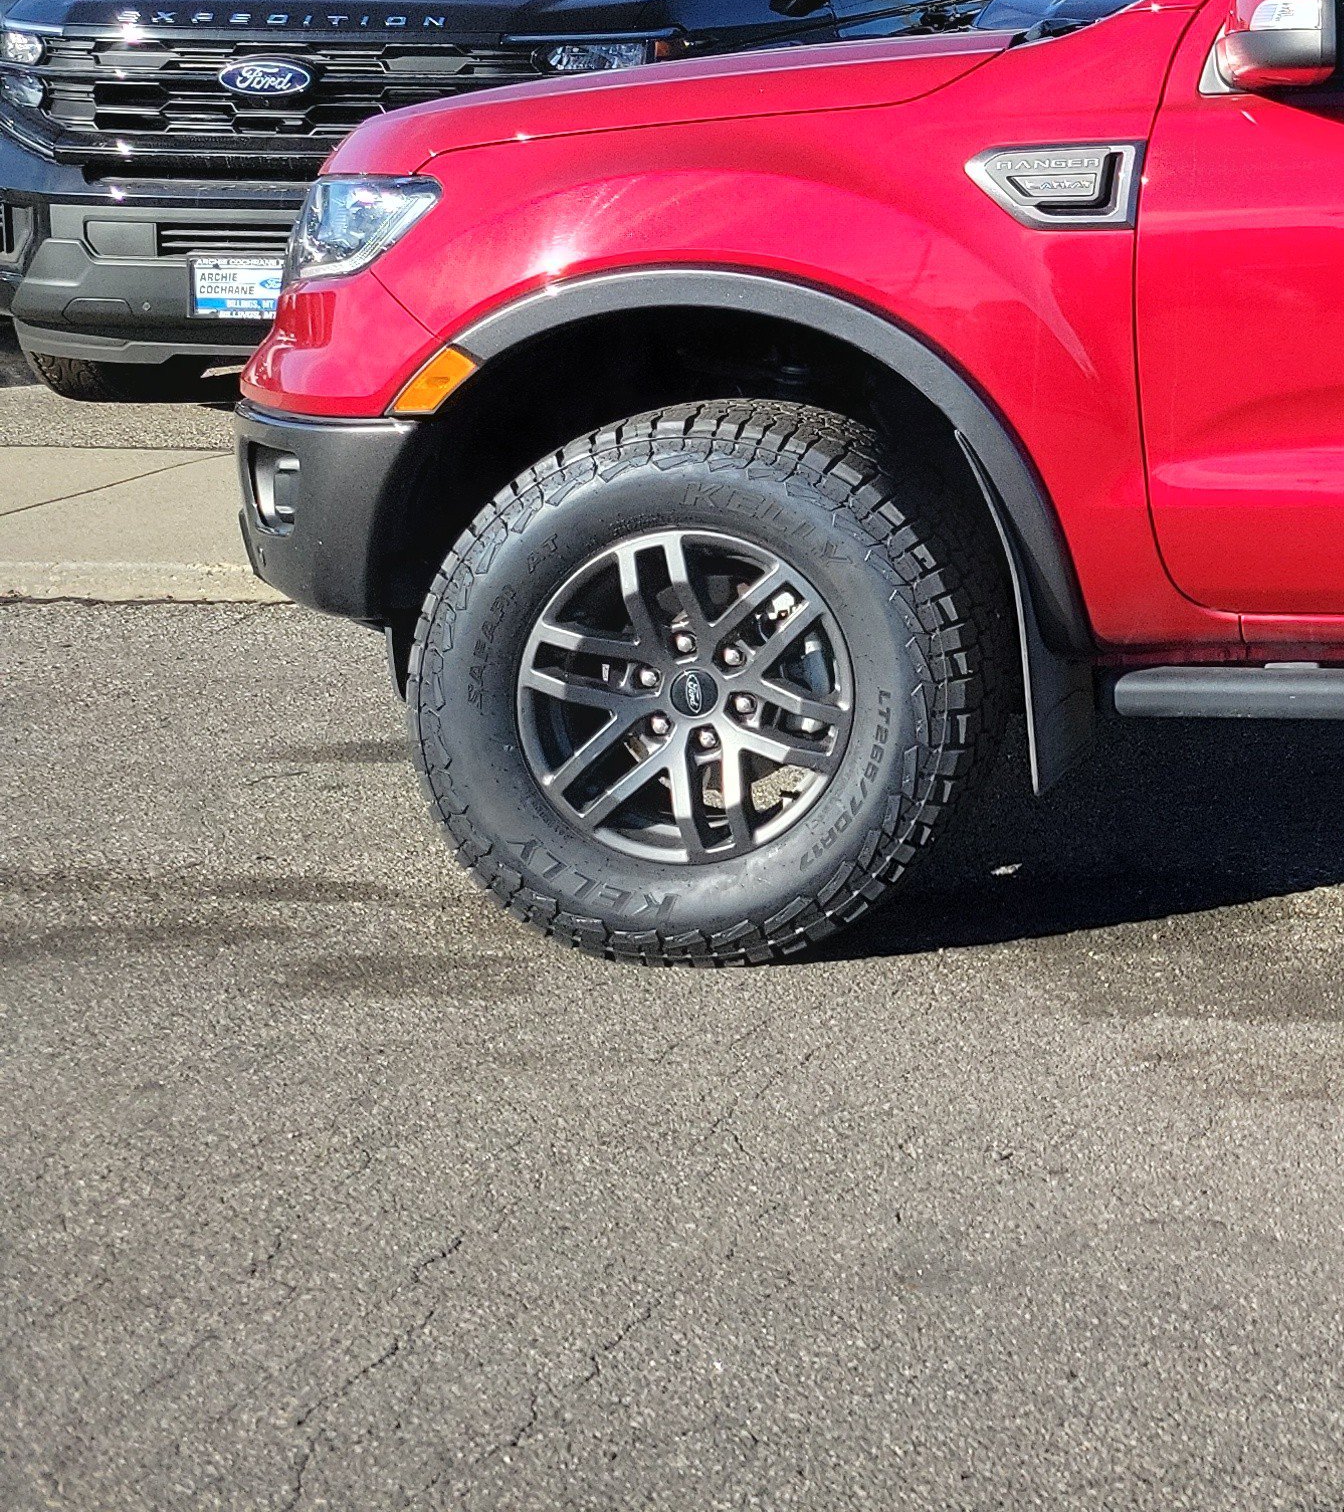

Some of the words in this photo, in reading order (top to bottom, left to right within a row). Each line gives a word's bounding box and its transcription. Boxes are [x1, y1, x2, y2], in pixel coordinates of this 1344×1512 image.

[117, 10, 446, 28] EXPEDITION
[236, 65, 294, 90] Ford
[996, 158, 1100, 171] RANGER
[199, 272, 238, 282] ARCHIE
[199, 285, 255, 295] COCHRANE
[505, 838, 682, 921] KELLY
